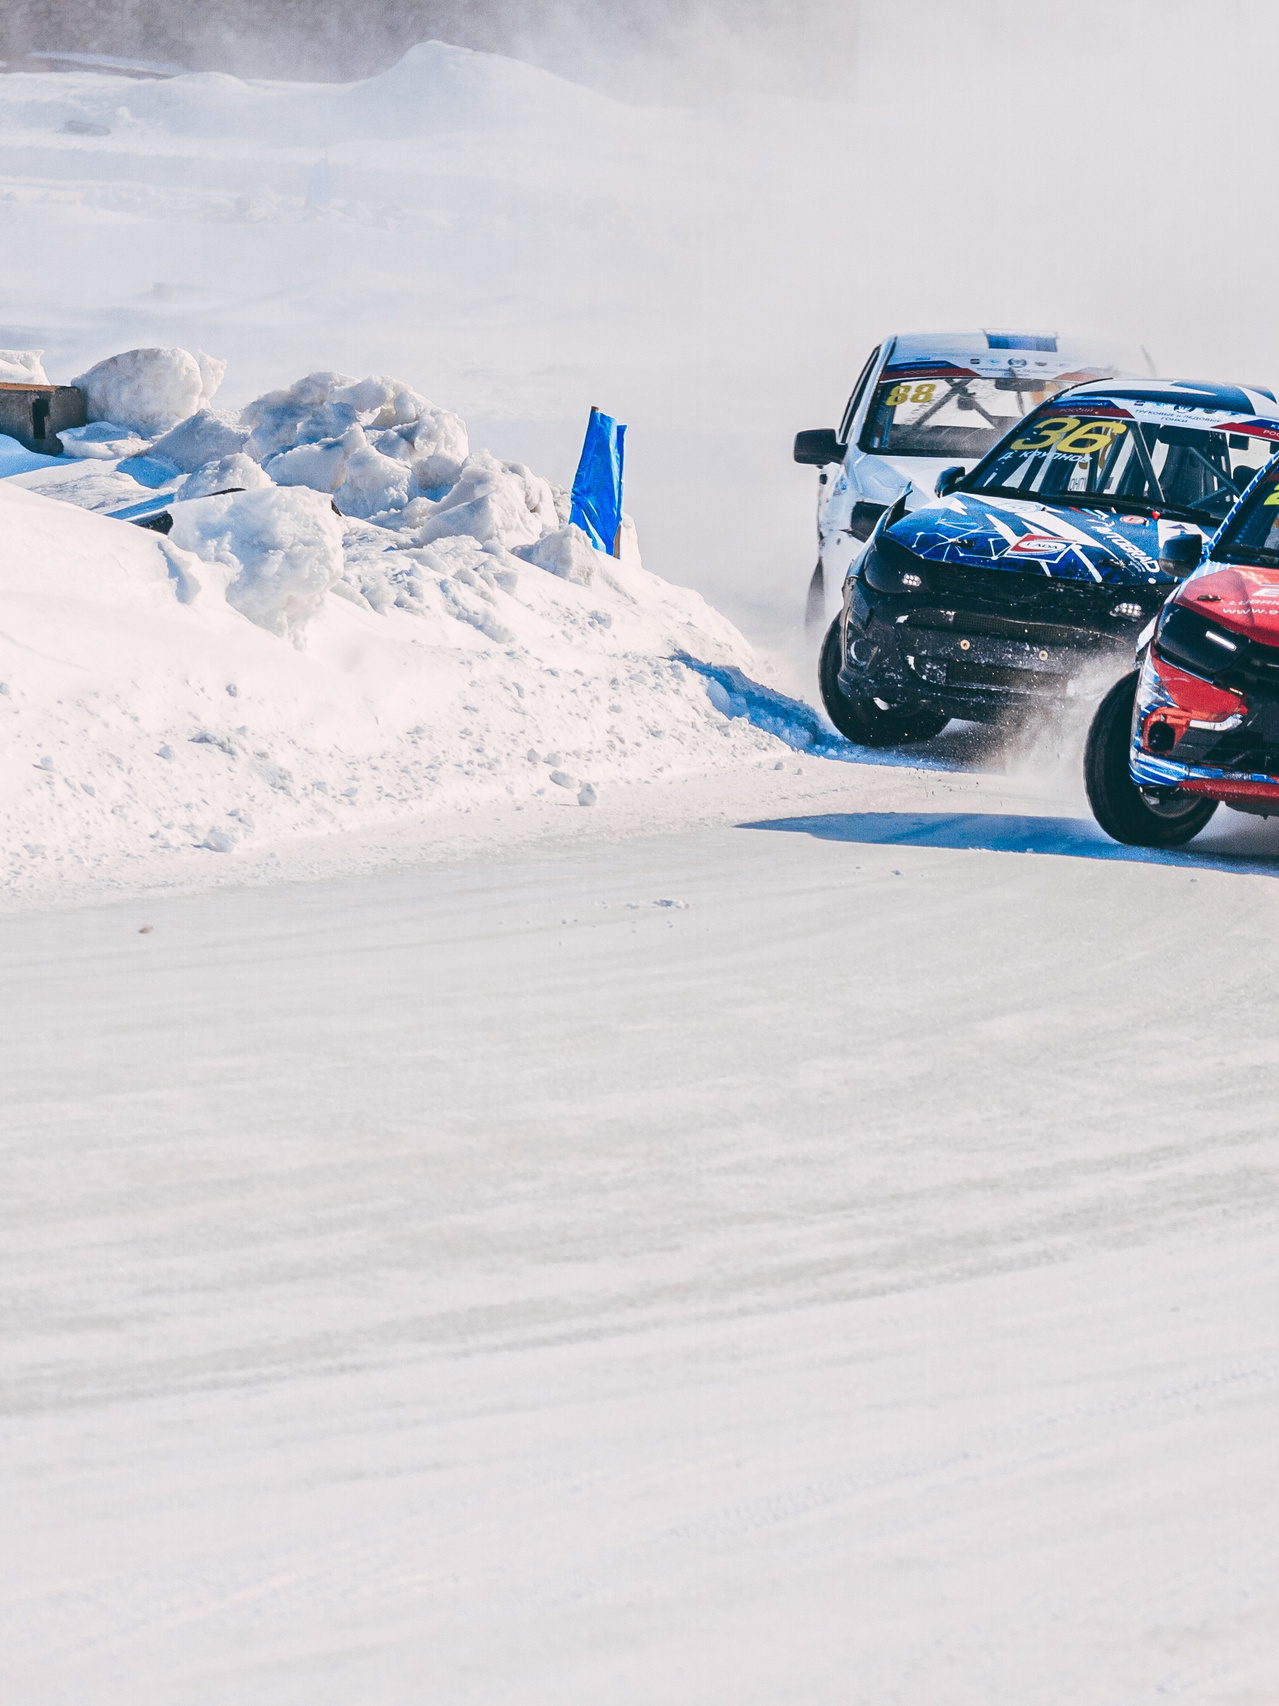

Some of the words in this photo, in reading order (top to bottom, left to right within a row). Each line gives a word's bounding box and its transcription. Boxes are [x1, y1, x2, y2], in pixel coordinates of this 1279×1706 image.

[885, 383, 937, 406] 88
[1010, 416, 1128, 454] 36
[1018, 450, 1093, 463] КРУПНОВ
[1026, 541, 1059, 551] LADA
